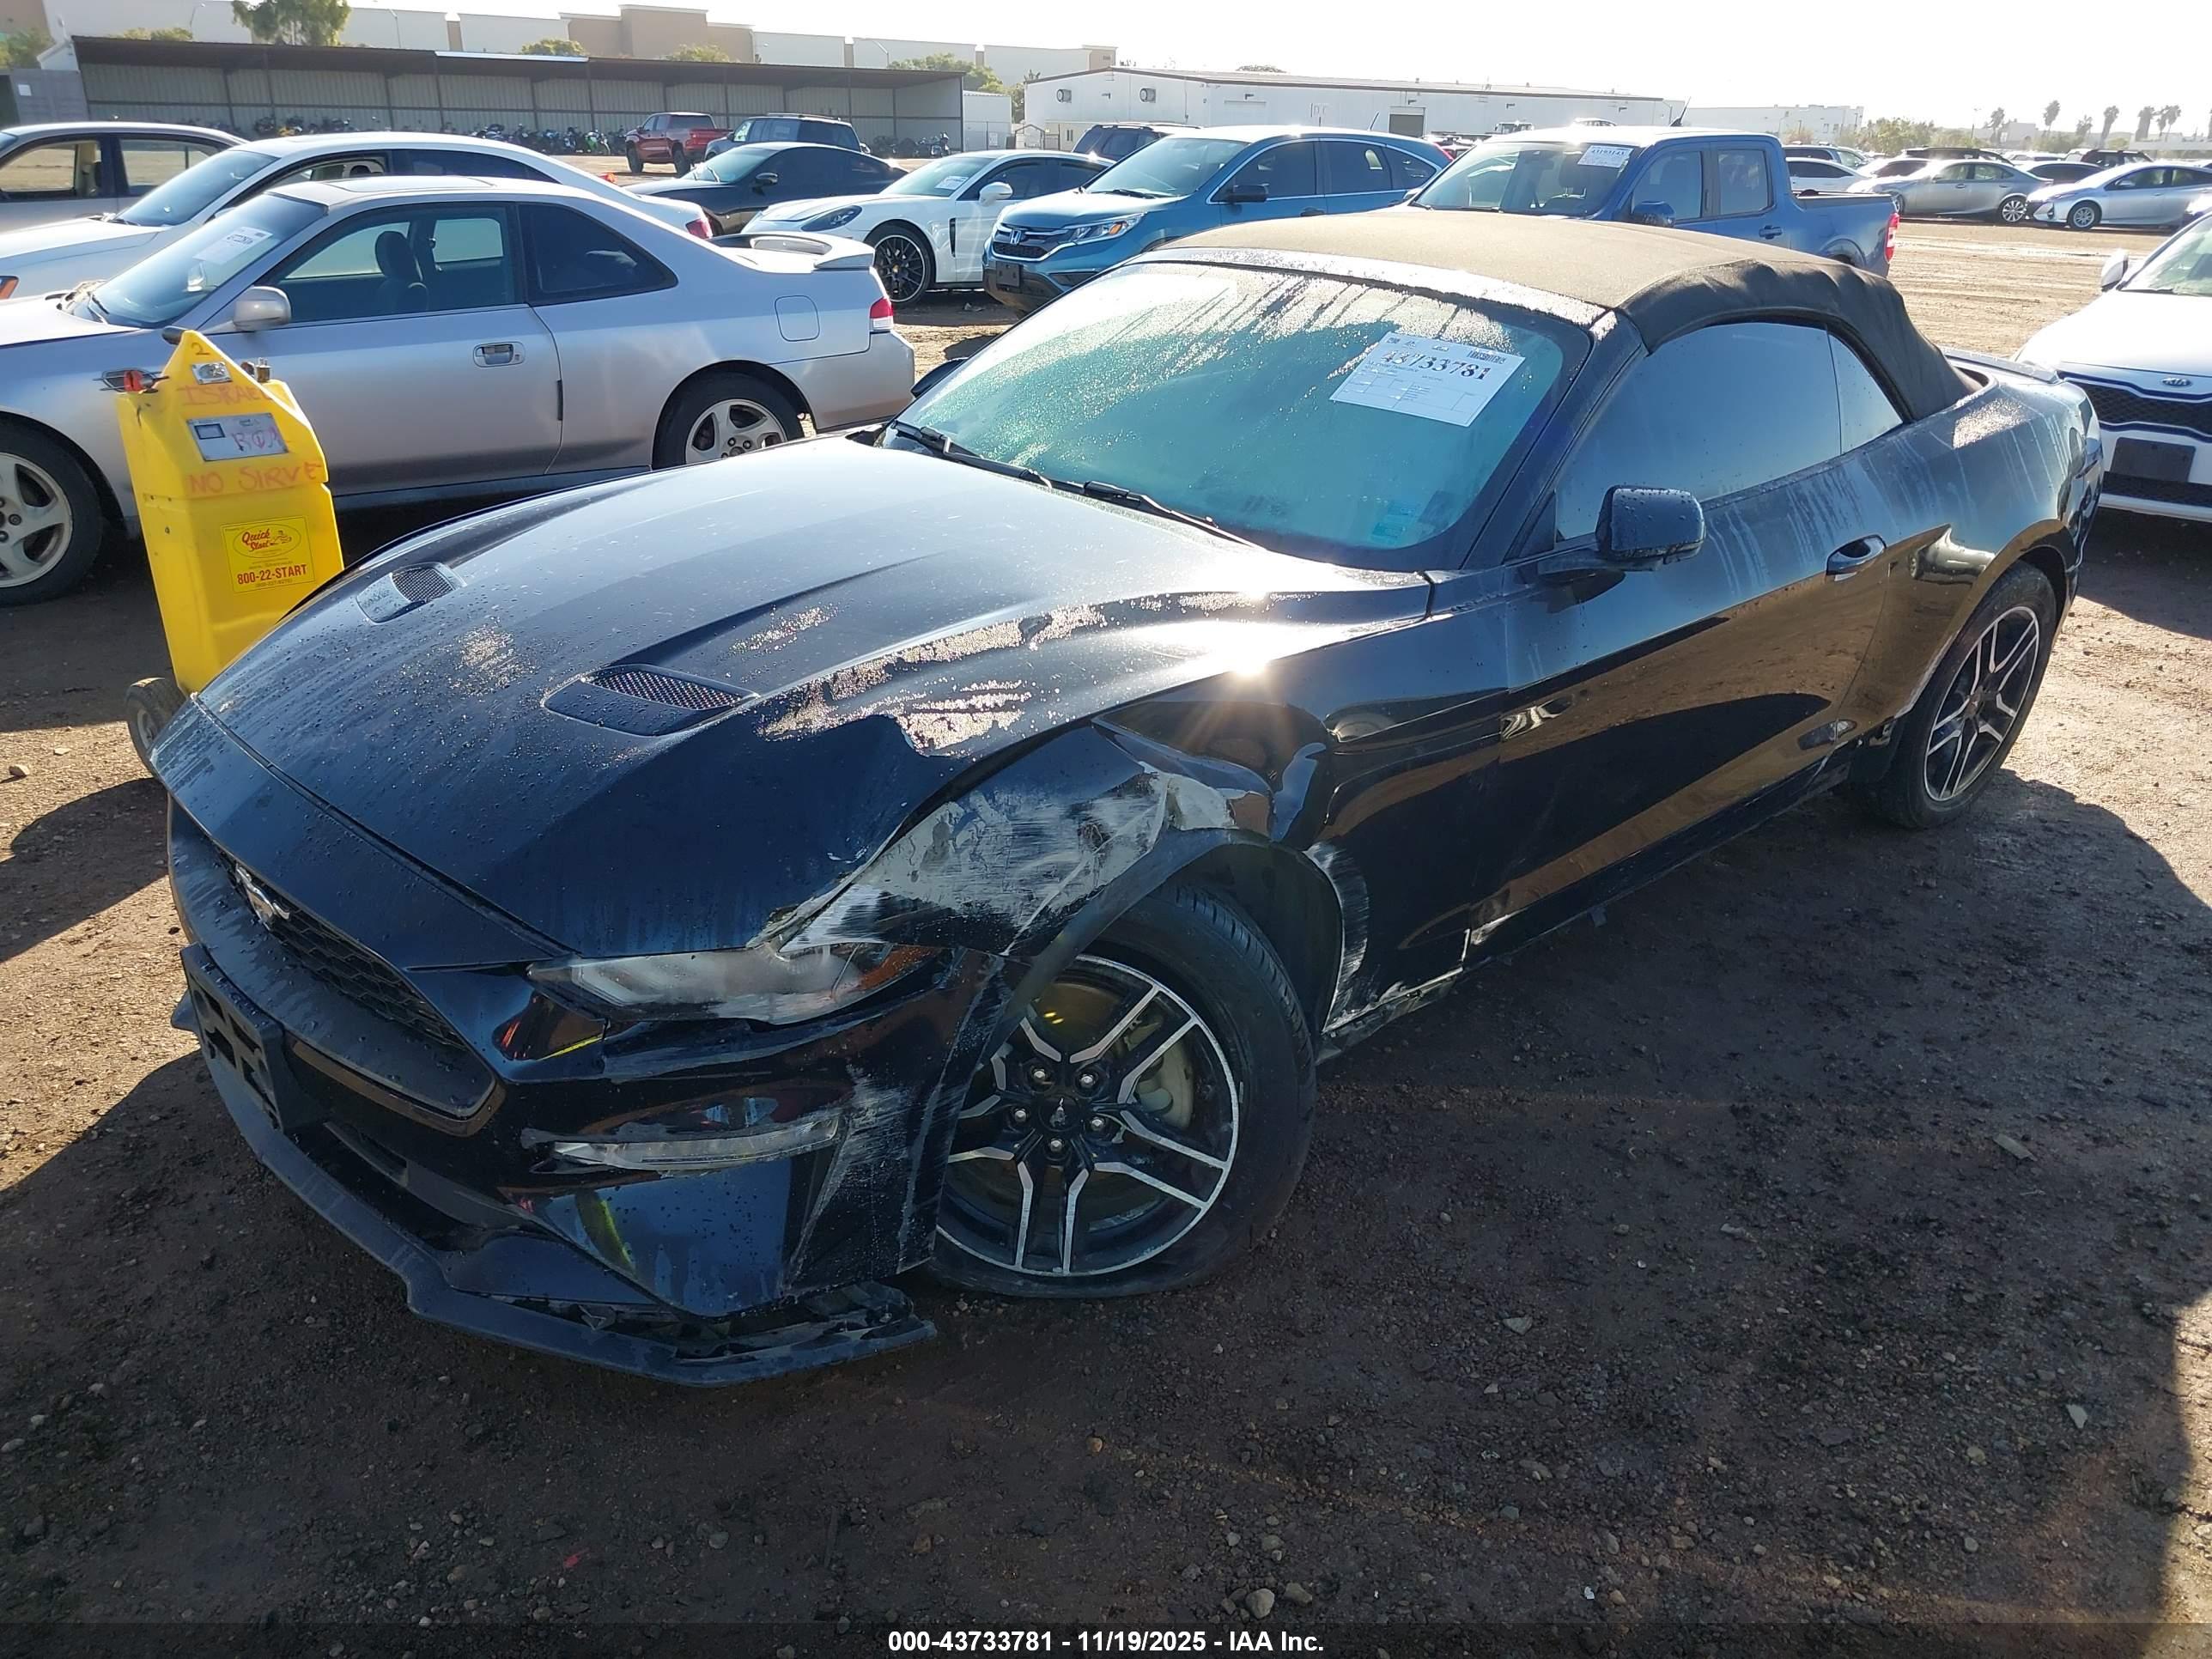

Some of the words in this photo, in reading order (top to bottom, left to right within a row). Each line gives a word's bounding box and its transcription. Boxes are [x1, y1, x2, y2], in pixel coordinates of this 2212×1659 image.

[191, 342, 211, 356] 2
[1382, 349, 1491, 380] 43733781
[189, 471, 224, 495] NO
[238, 462, 322, 491] SIRVE
[241, 528, 270, 545] Quick
[249, 540, 269, 552] Start
[237, 564, 307, 584] 800-22-START
